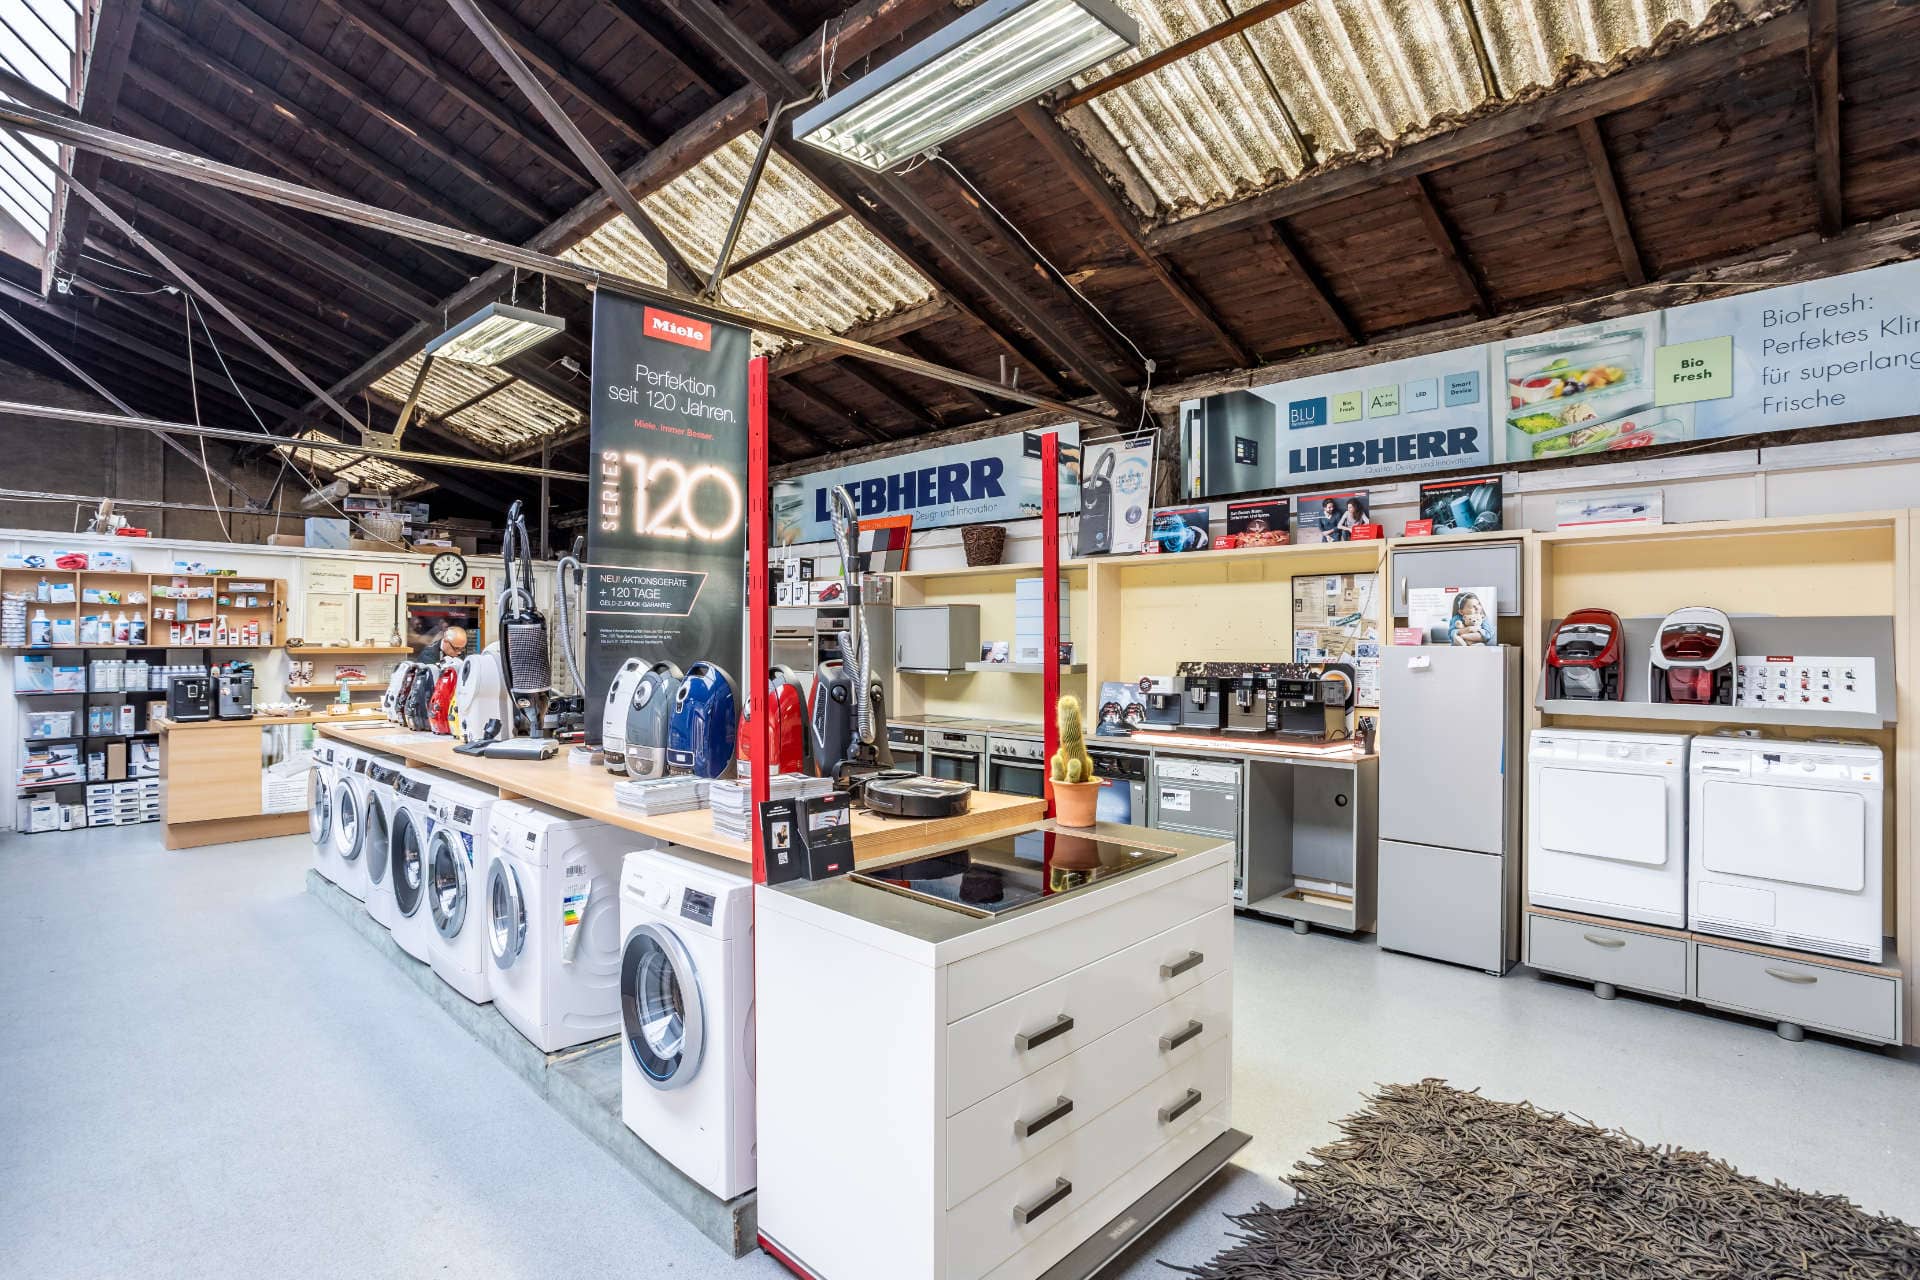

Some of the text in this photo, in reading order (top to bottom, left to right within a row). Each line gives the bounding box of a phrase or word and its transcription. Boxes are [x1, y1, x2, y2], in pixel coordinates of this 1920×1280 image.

[1762, 292, 1873, 328] BioFresh:
[652, 317, 704, 341] Miele
[1762, 325, 1869, 358] Perfektes
[1673, 368, 1713, 384] Fresh
[1680, 358, 1705, 370] Bio
[1761, 366, 1791, 386] für
[635, 363, 716, 399] Perfektion
[1451, 380, 1472, 389] Smart
[608, 385, 737, 424] seit 120 Jahren.
[1762, 388, 1846, 415] Frische
[1291, 406, 1315, 423] BLU
[1289, 426, 1480, 474] LIEBHERR
[602, 450, 618, 531] SERIES
[624, 453, 743, 541] 120
[815, 456, 1006, 523] LEBHERR
[940, 508, 955, 518] und
[956, 503, 999, 516] Innovation
[384, 577, 395, 592] F
[611, 587, 630, 598] 120
[632, 587, 662, 600] TAGE
[622, 576, 688, 588] AKTIONSGERÄTE
